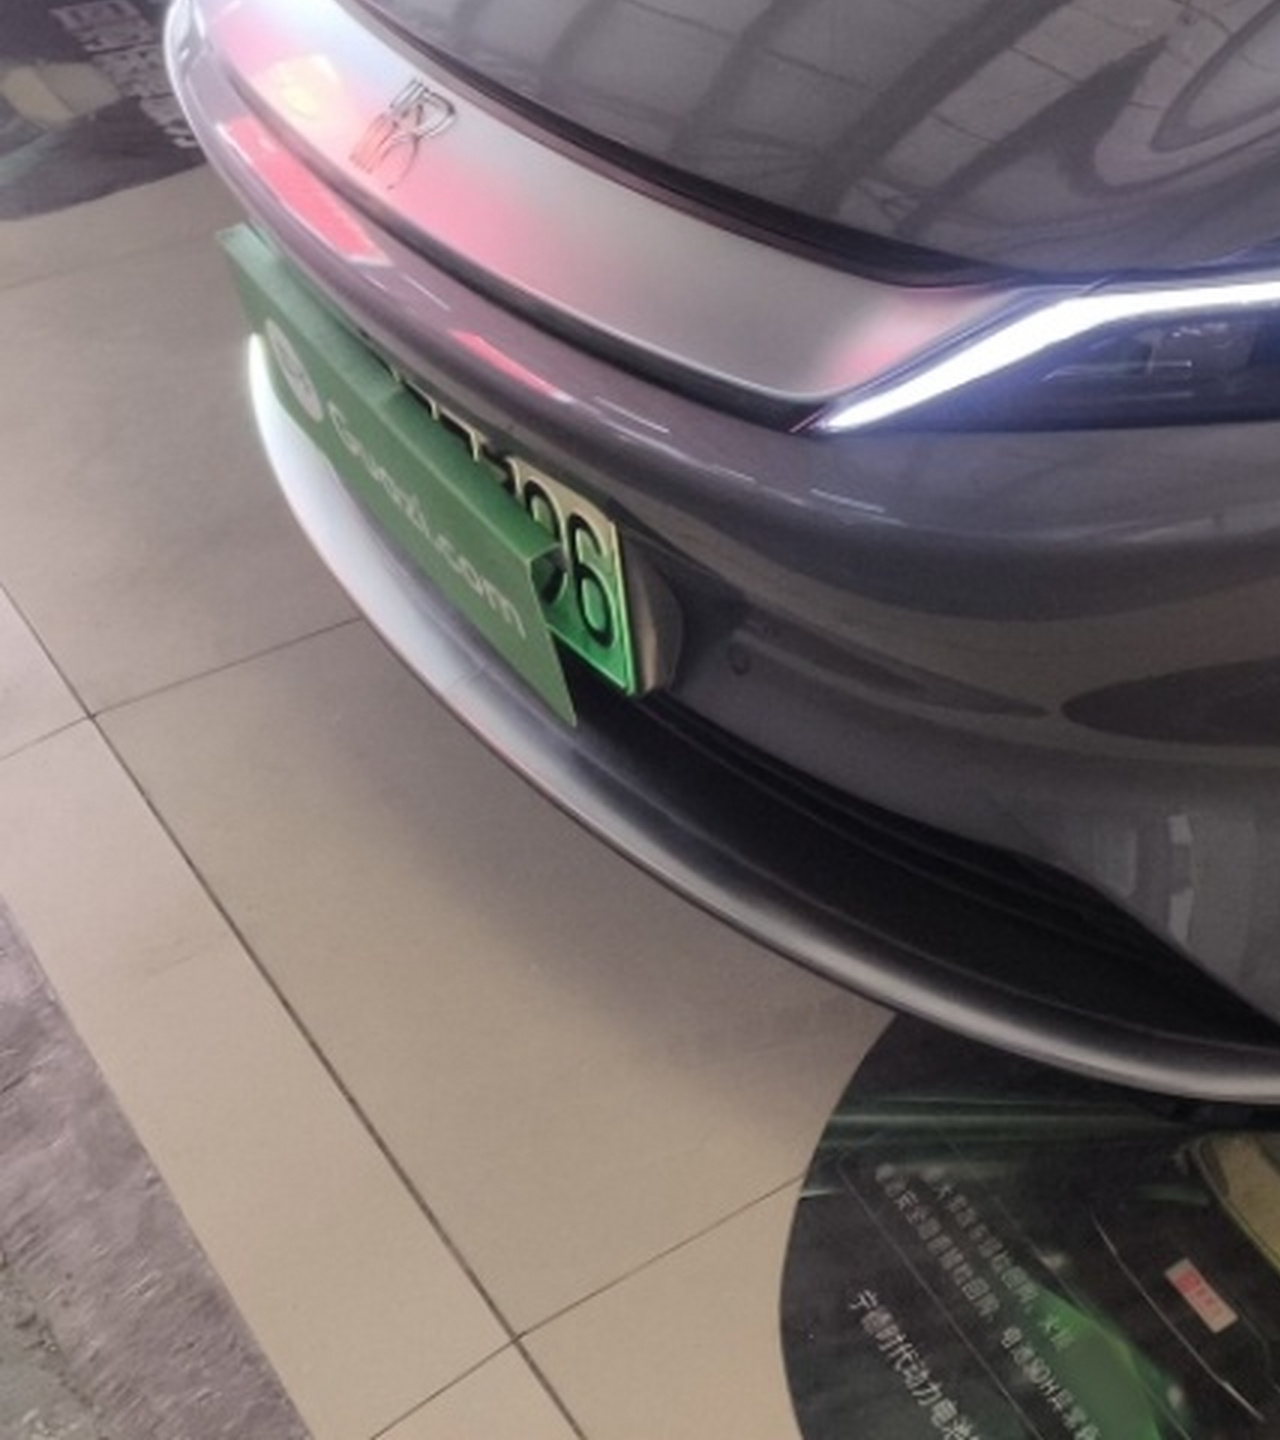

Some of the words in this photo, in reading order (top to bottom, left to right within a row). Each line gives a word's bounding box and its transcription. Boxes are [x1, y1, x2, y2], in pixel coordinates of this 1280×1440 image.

[848, 1289, 981, 1440] 宁德时代动力电池
